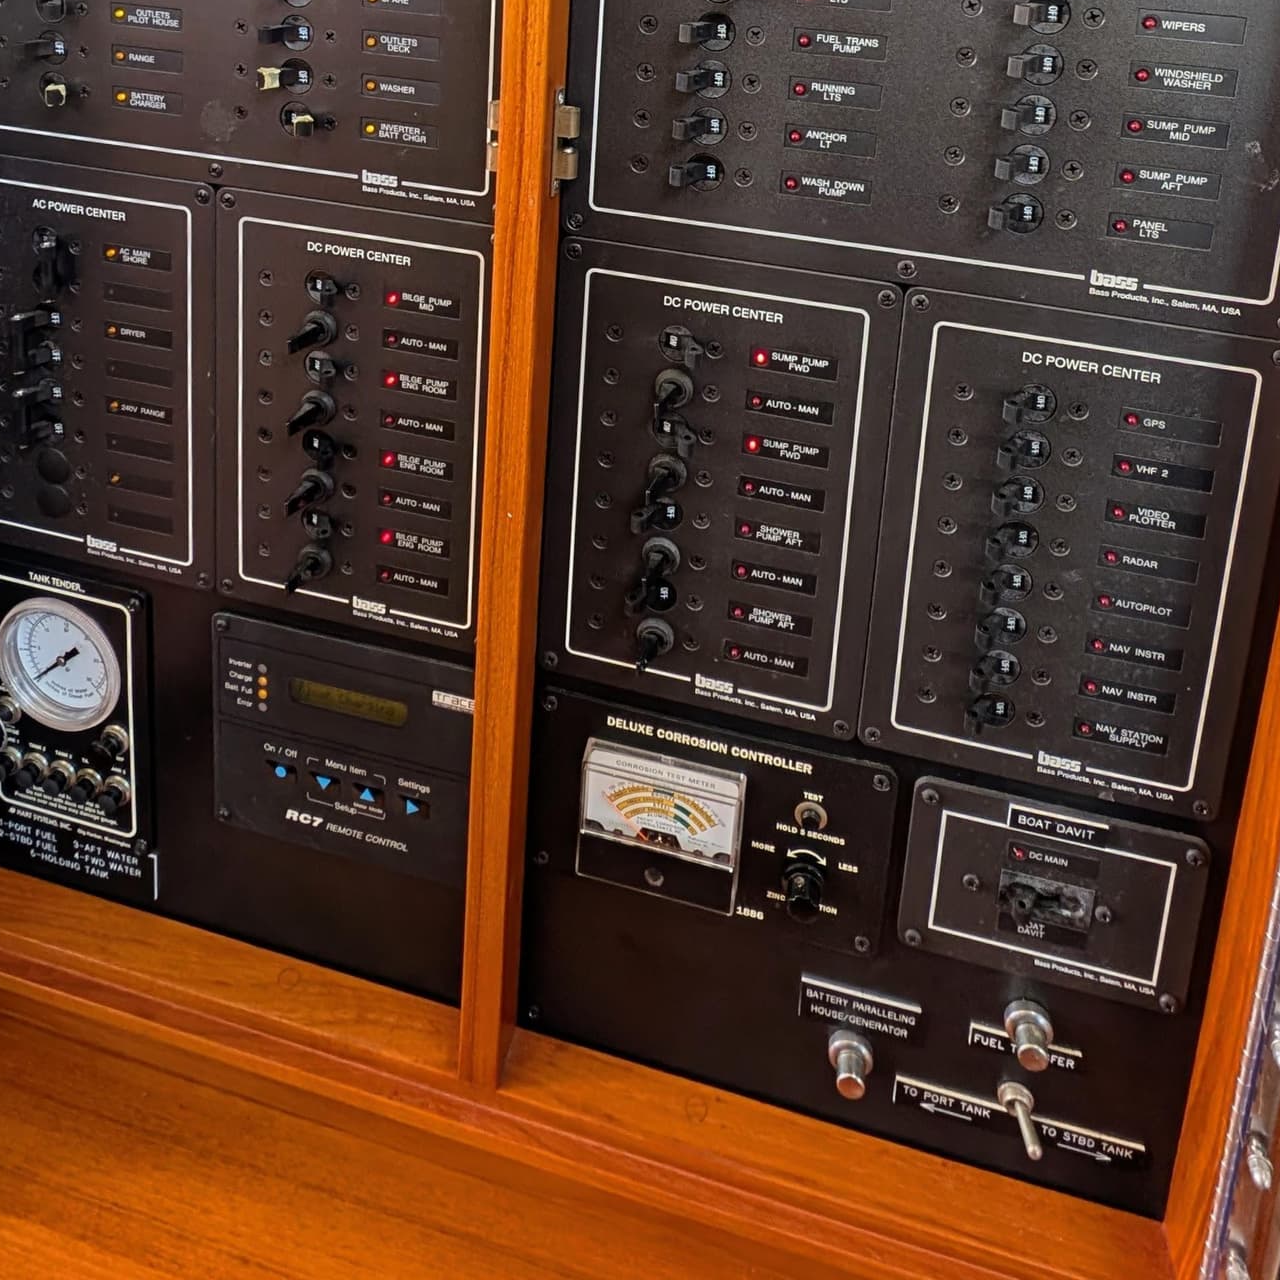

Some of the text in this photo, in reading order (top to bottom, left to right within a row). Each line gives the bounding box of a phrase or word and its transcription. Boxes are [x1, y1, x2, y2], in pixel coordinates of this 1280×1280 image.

[1162, 20, 1205, 32] WIPERS
[816, 34, 879, 48] FUEL TRANS
[833, 44, 861, 54] PUMP
[1154, 68, 1223, 83] WINDSHIELD
[811, 83, 855, 95] RUNNING
[1163, 78, 1212, 91] WASHER
[824, 92, 841, 102] LTS
[806, 131, 847, 143] ANCHOR
[820, 140, 831, 148] LT
[802, 177, 865, 192] WASH DOWN
[819, 187, 846, 197] PUMP
[33, 199, 125, 221] AC POWER CENTER
[1133, 220, 1168, 232] PANEL
[1139, 229, 1160, 239] LTS
[307, 242, 411, 266] DC POWER CENTER
[663, 296, 783, 323] DC POWER CENTER
[1089, 288, 1110, 296] Bass
[1221, 307, 1241, 316] USA
[1022, 352, 1161, 384] DC POWER CENTER
[1143, 418, 1165, 430] GPS
[1122, 556, 1158, 569] RADAR
[29, 572, 50, 586] TANK
[1115, 597, 1172, 616] AUTOPILOT
[607, 716, 813, 774] DELUXE CORROSION CONTROLLER
[285, 809, 408, 852] RC7 REMOTE CONTROL
[1018, 815, 1094, 840] BOAT DAVIT
[807, 988, 916, 1026] BATTERY PARALLELING
[810, 1005, 908, 1038] HOUSE/GENERATOR
[974, 1034, 1005, 1051] FUEL
[903, 1085, 991, 1119] TO PORT TANK
[1042, 1125, 1133, 1159] TO STBD TANK
